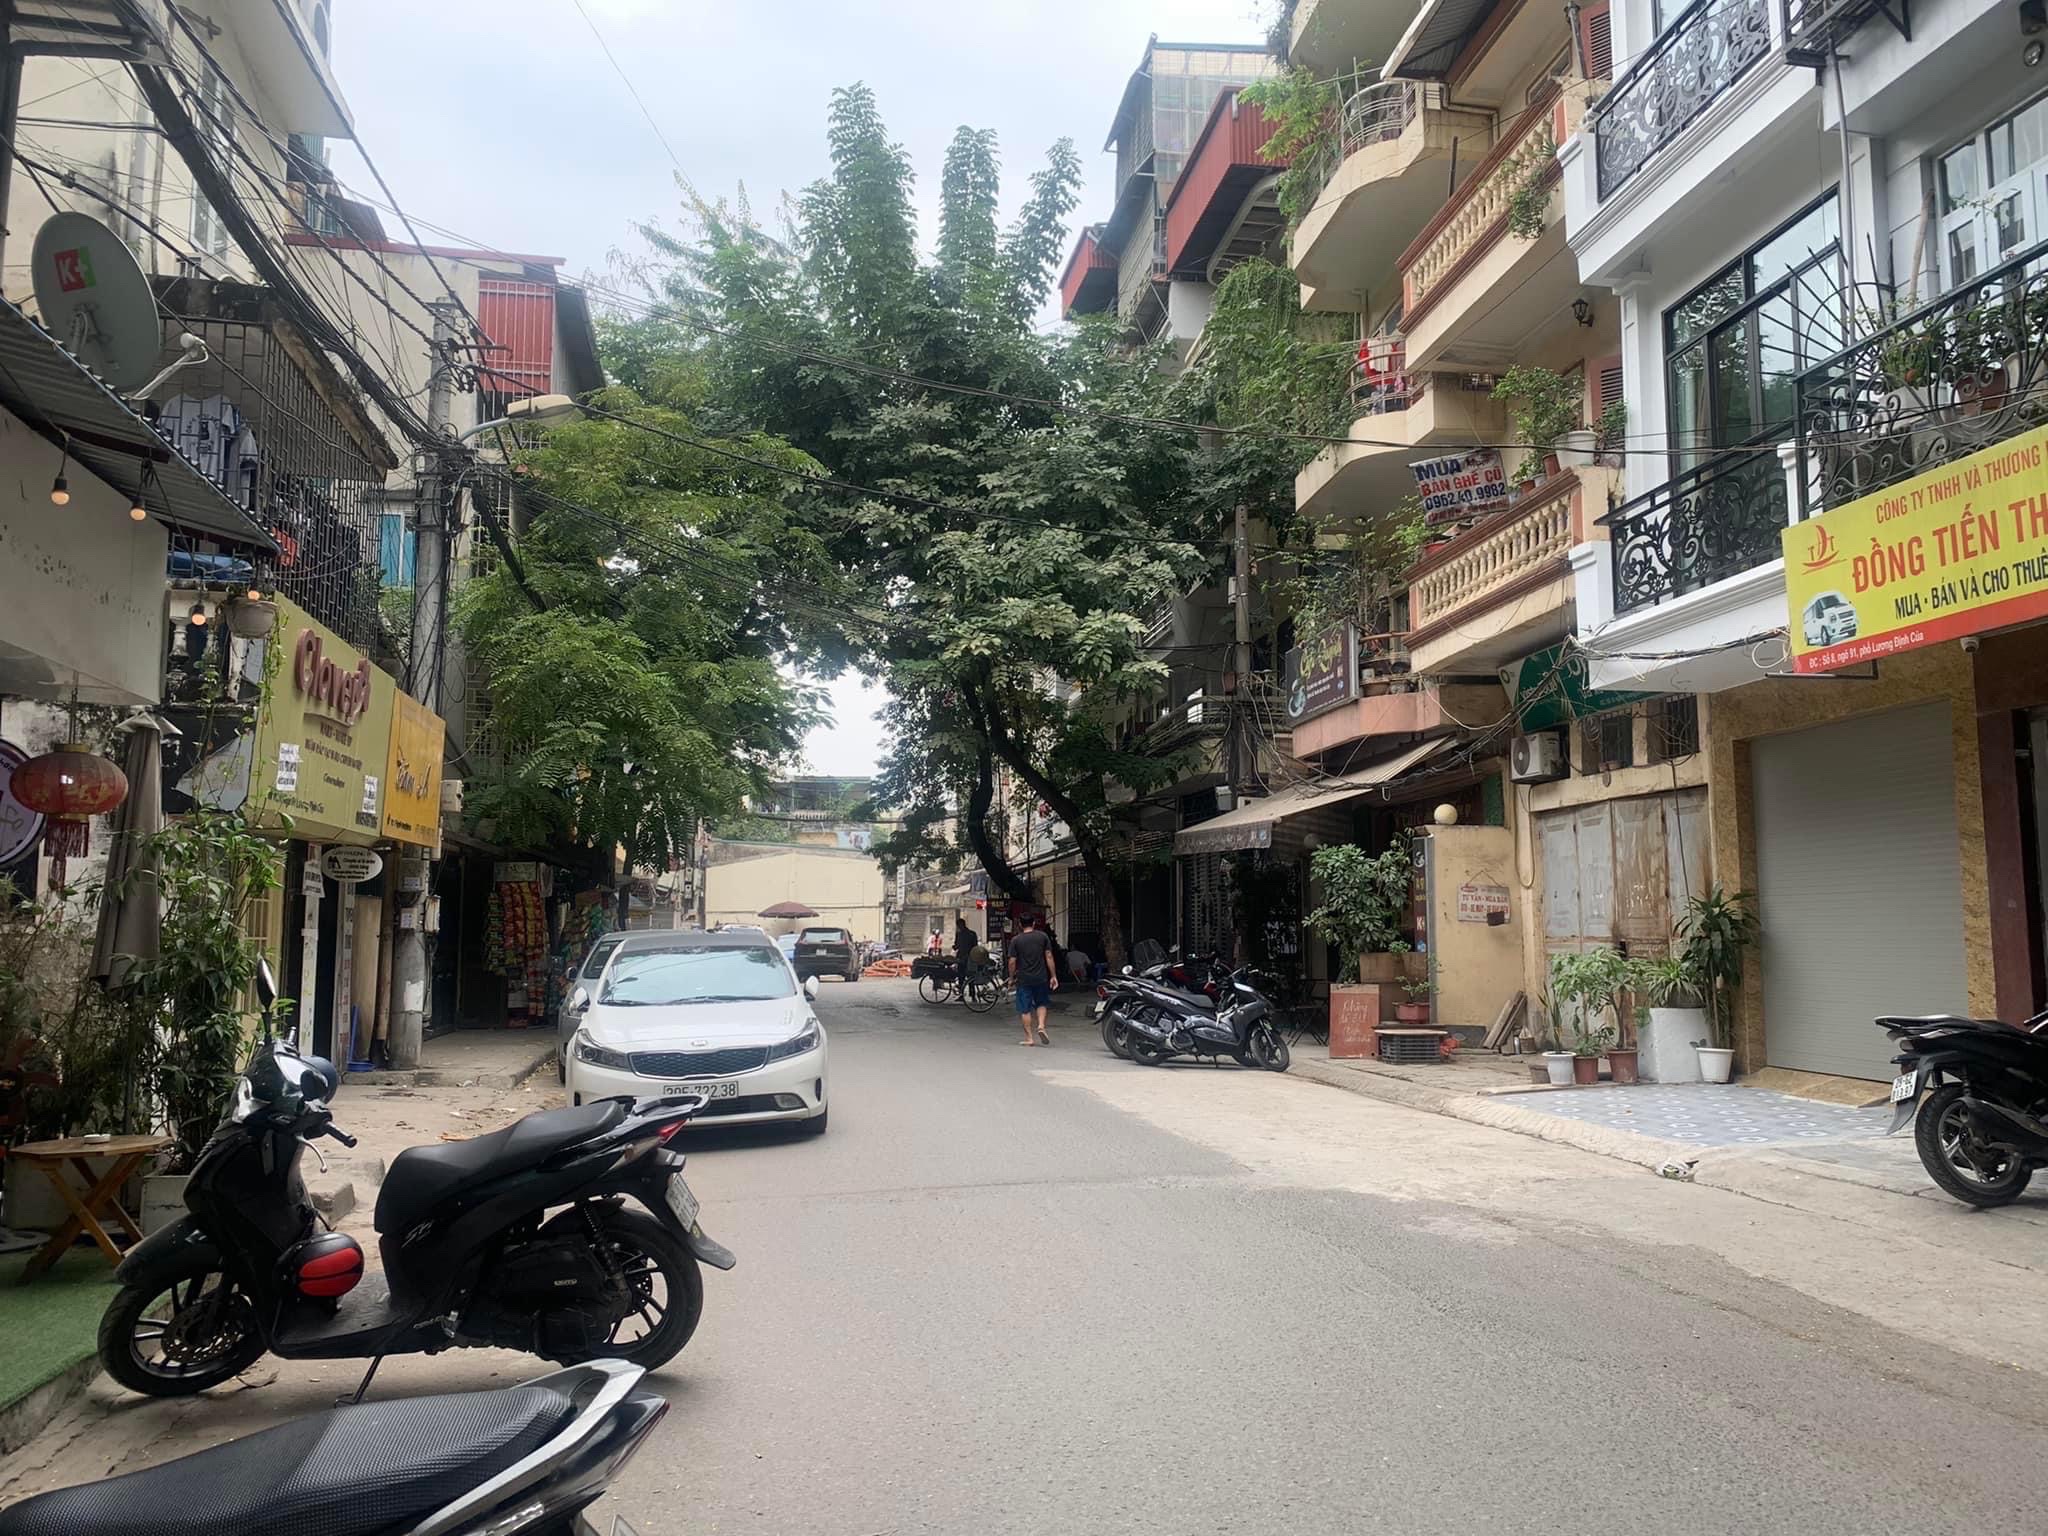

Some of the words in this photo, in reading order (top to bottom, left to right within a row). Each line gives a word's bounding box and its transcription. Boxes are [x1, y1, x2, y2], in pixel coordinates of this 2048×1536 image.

[1876, 495, 1908, 524] CÔNG
[1910, 488, 1924, 511] TY
[1927, 475, 1961, 504] TNHH
[1964, 464, 1983, 490] VÀ
[1984, 444, 2041, 484] THƯƠNG
[1852, 536, 1926, 593] ĐỒNG
[1932, 502, 2000, 567] TIẾN
[1895, 592, 1922, 620] MUA
[1931, 576, 1957, 609] BÁN
[1960, 567, 1980, 600] VÀ
[1982, 566, 2009, 595] CHO
